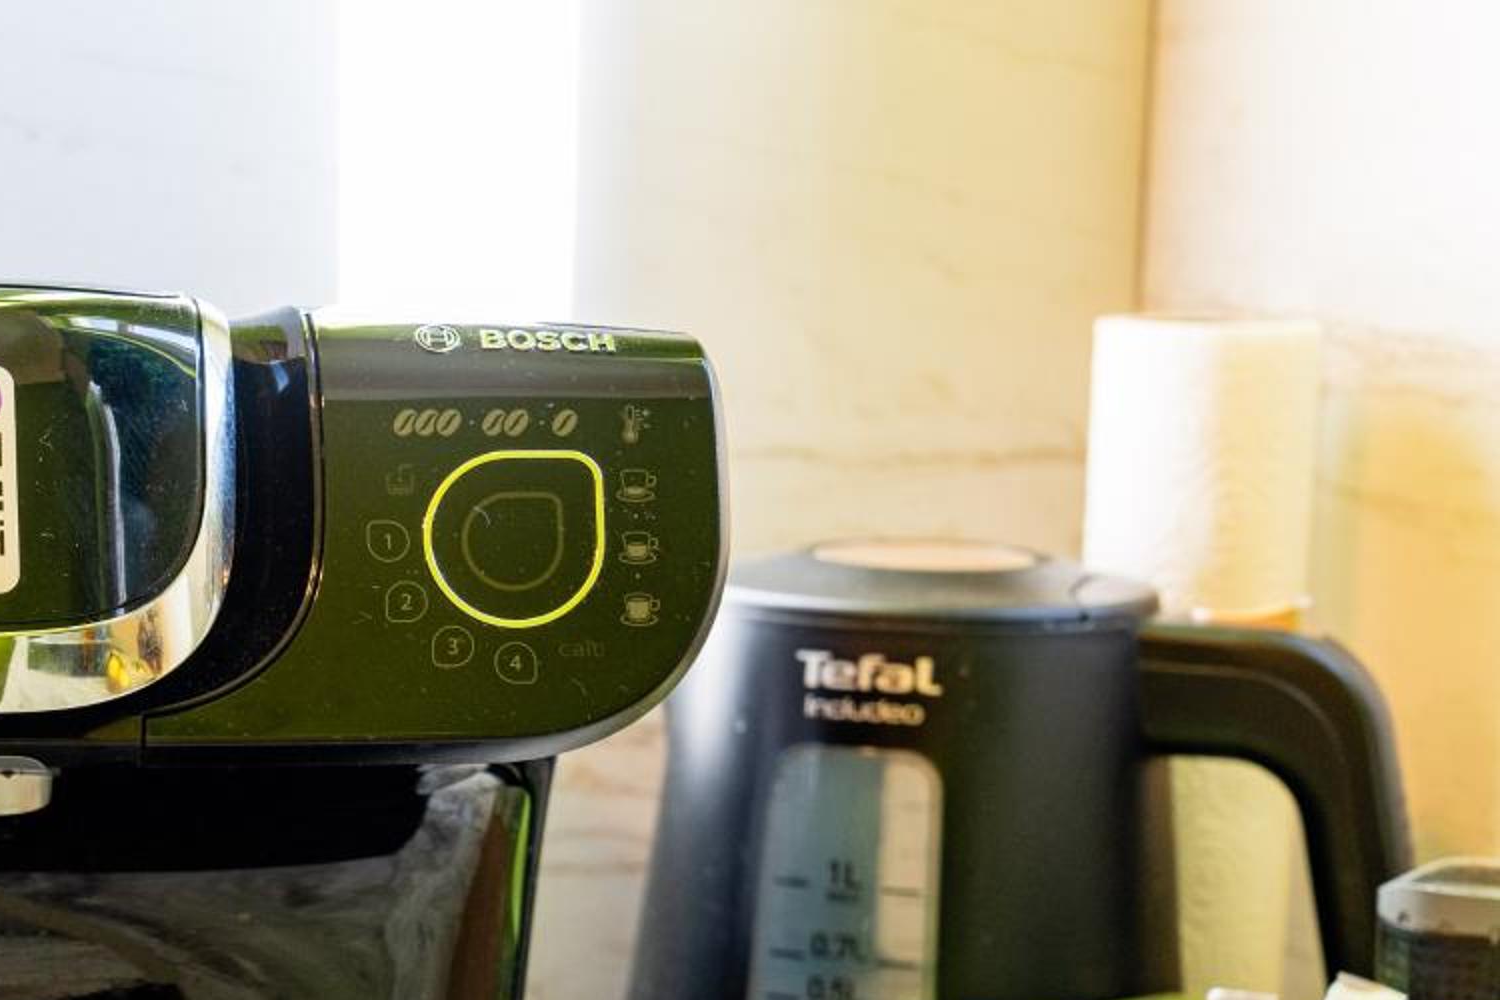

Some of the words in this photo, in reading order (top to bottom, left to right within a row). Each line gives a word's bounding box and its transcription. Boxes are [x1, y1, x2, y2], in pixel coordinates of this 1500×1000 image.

[479, 329, 616, 353] BOSCH
[401, 593, 414, 611] 2
[448, 636, 459, 655] 3
[509, 654, 522, 671] 4
[795, 648, 943, 697] Tefal
